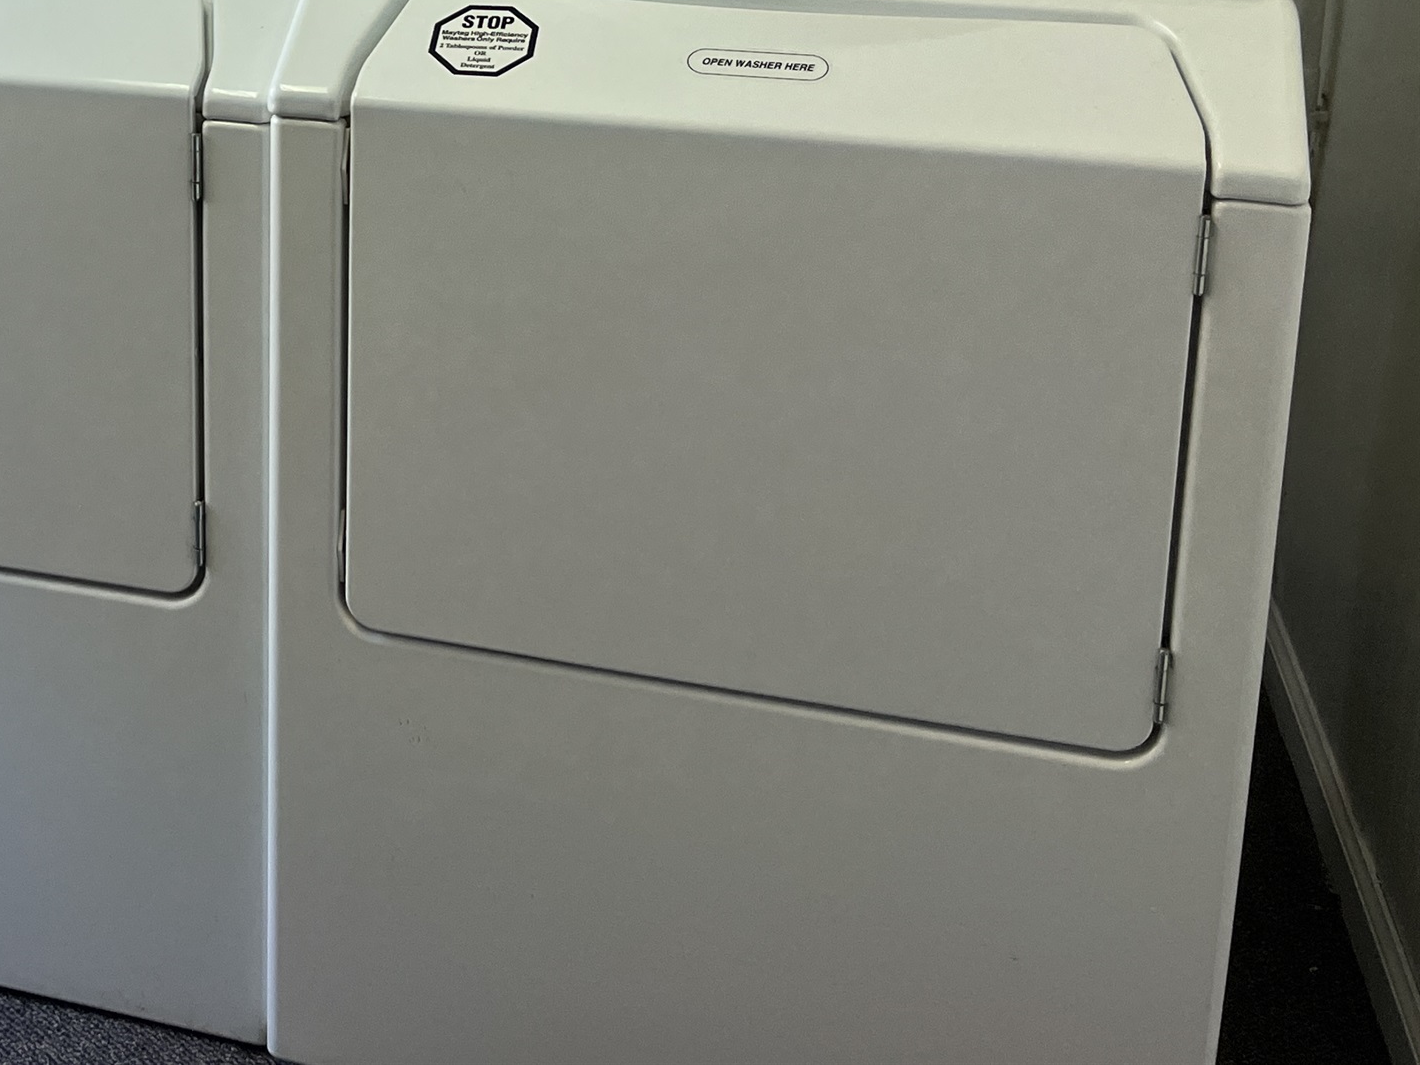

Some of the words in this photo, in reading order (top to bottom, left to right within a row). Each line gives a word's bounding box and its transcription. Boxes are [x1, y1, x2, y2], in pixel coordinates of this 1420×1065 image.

[462, 14, 515, 29] STOP
[471, 30, 529, 39] High-Efficiency
[702, 57, 733, 67] OPEN
[735, 59, 783, 70] WASHER
[784, 63, 815, 72] HERE
